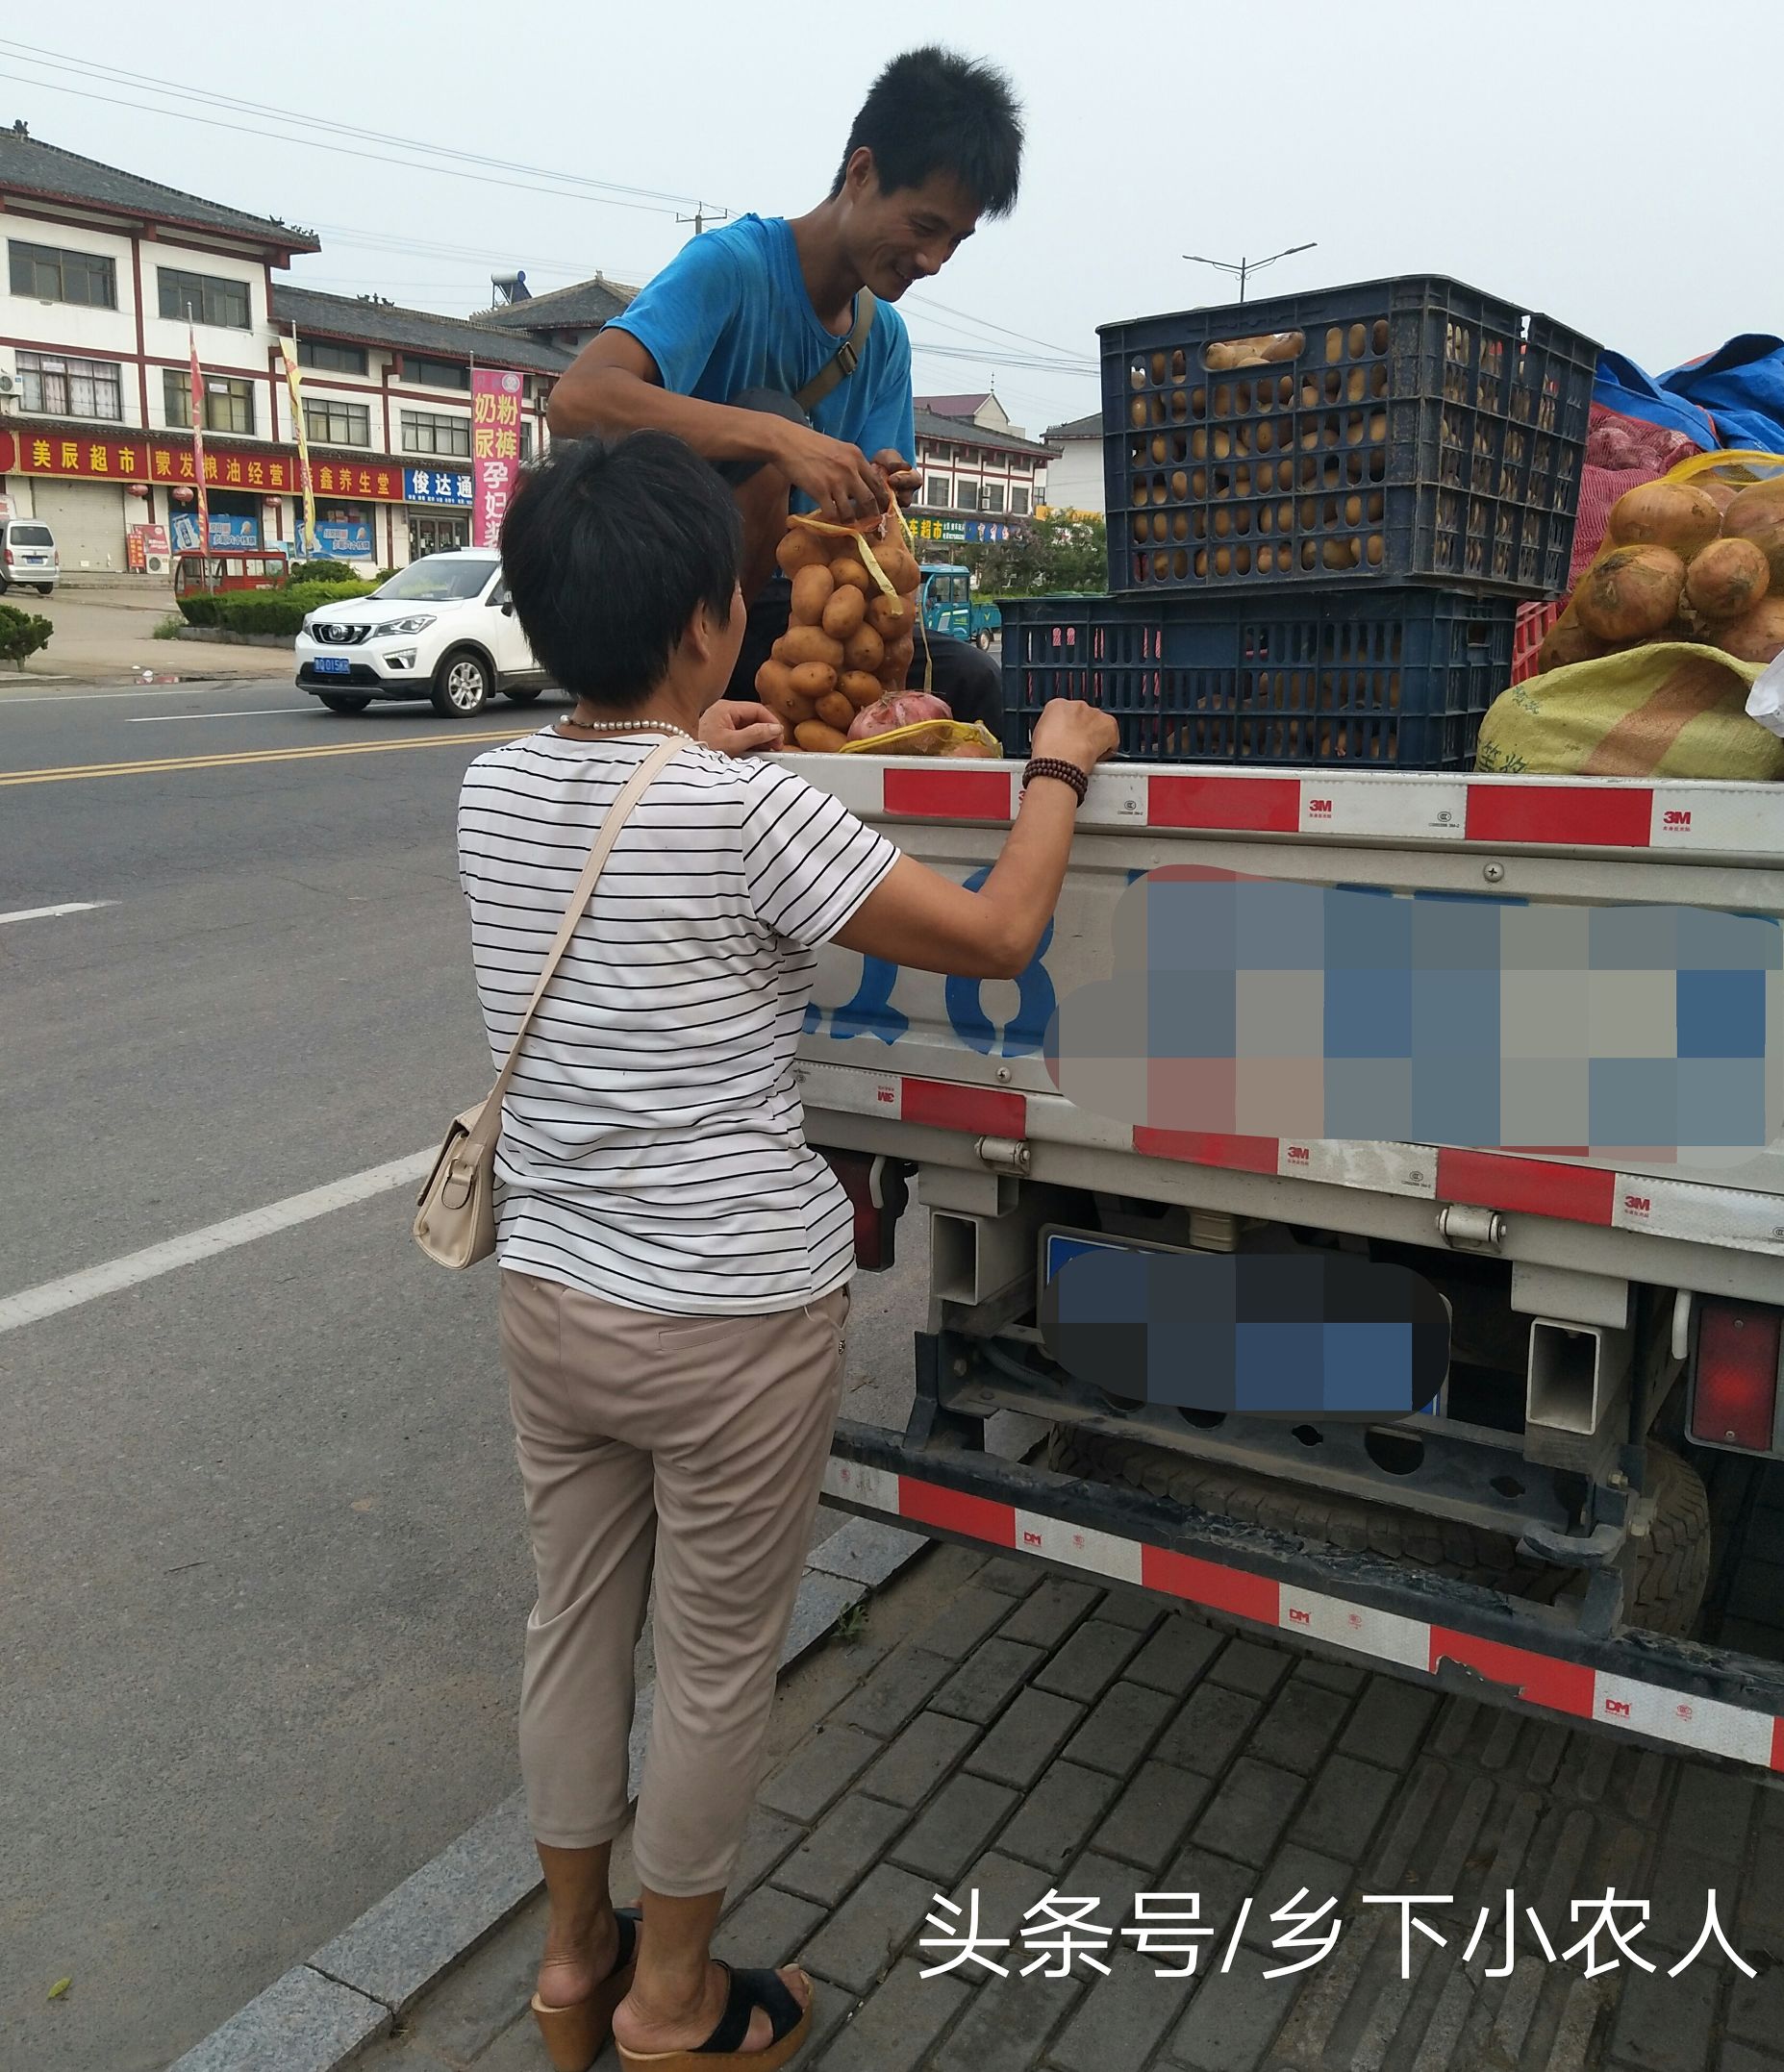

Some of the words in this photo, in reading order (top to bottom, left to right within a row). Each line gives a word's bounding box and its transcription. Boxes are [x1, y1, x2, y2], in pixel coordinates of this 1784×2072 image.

[474, 392, 518, 426] 奶粉
[475, 428, 516, 460] 尿裤
[33, 439, 135, 473] 美辰超市
[155, 450, 283, 486] 蒙发粮油经营
[300, 465, 389, 495] 鑫养生堂
[412, 469, 473, 498] 俊达通
[897, 518, 942, 539] 车超市
[1309, 799, 1332, 811] 3M
[1664, 811, 1691, 824] 3M
[877, 1090, 894, 1103] 3M
[1288, 1146, 1309, 1160] 3M
[1624, 1195, 1650, 1211] 3M
[1023, 1531, 1042, 1546] DM
[1289, 1608, 1310, 1624] DM
[1605, 1699, 1630, 1715] DM
